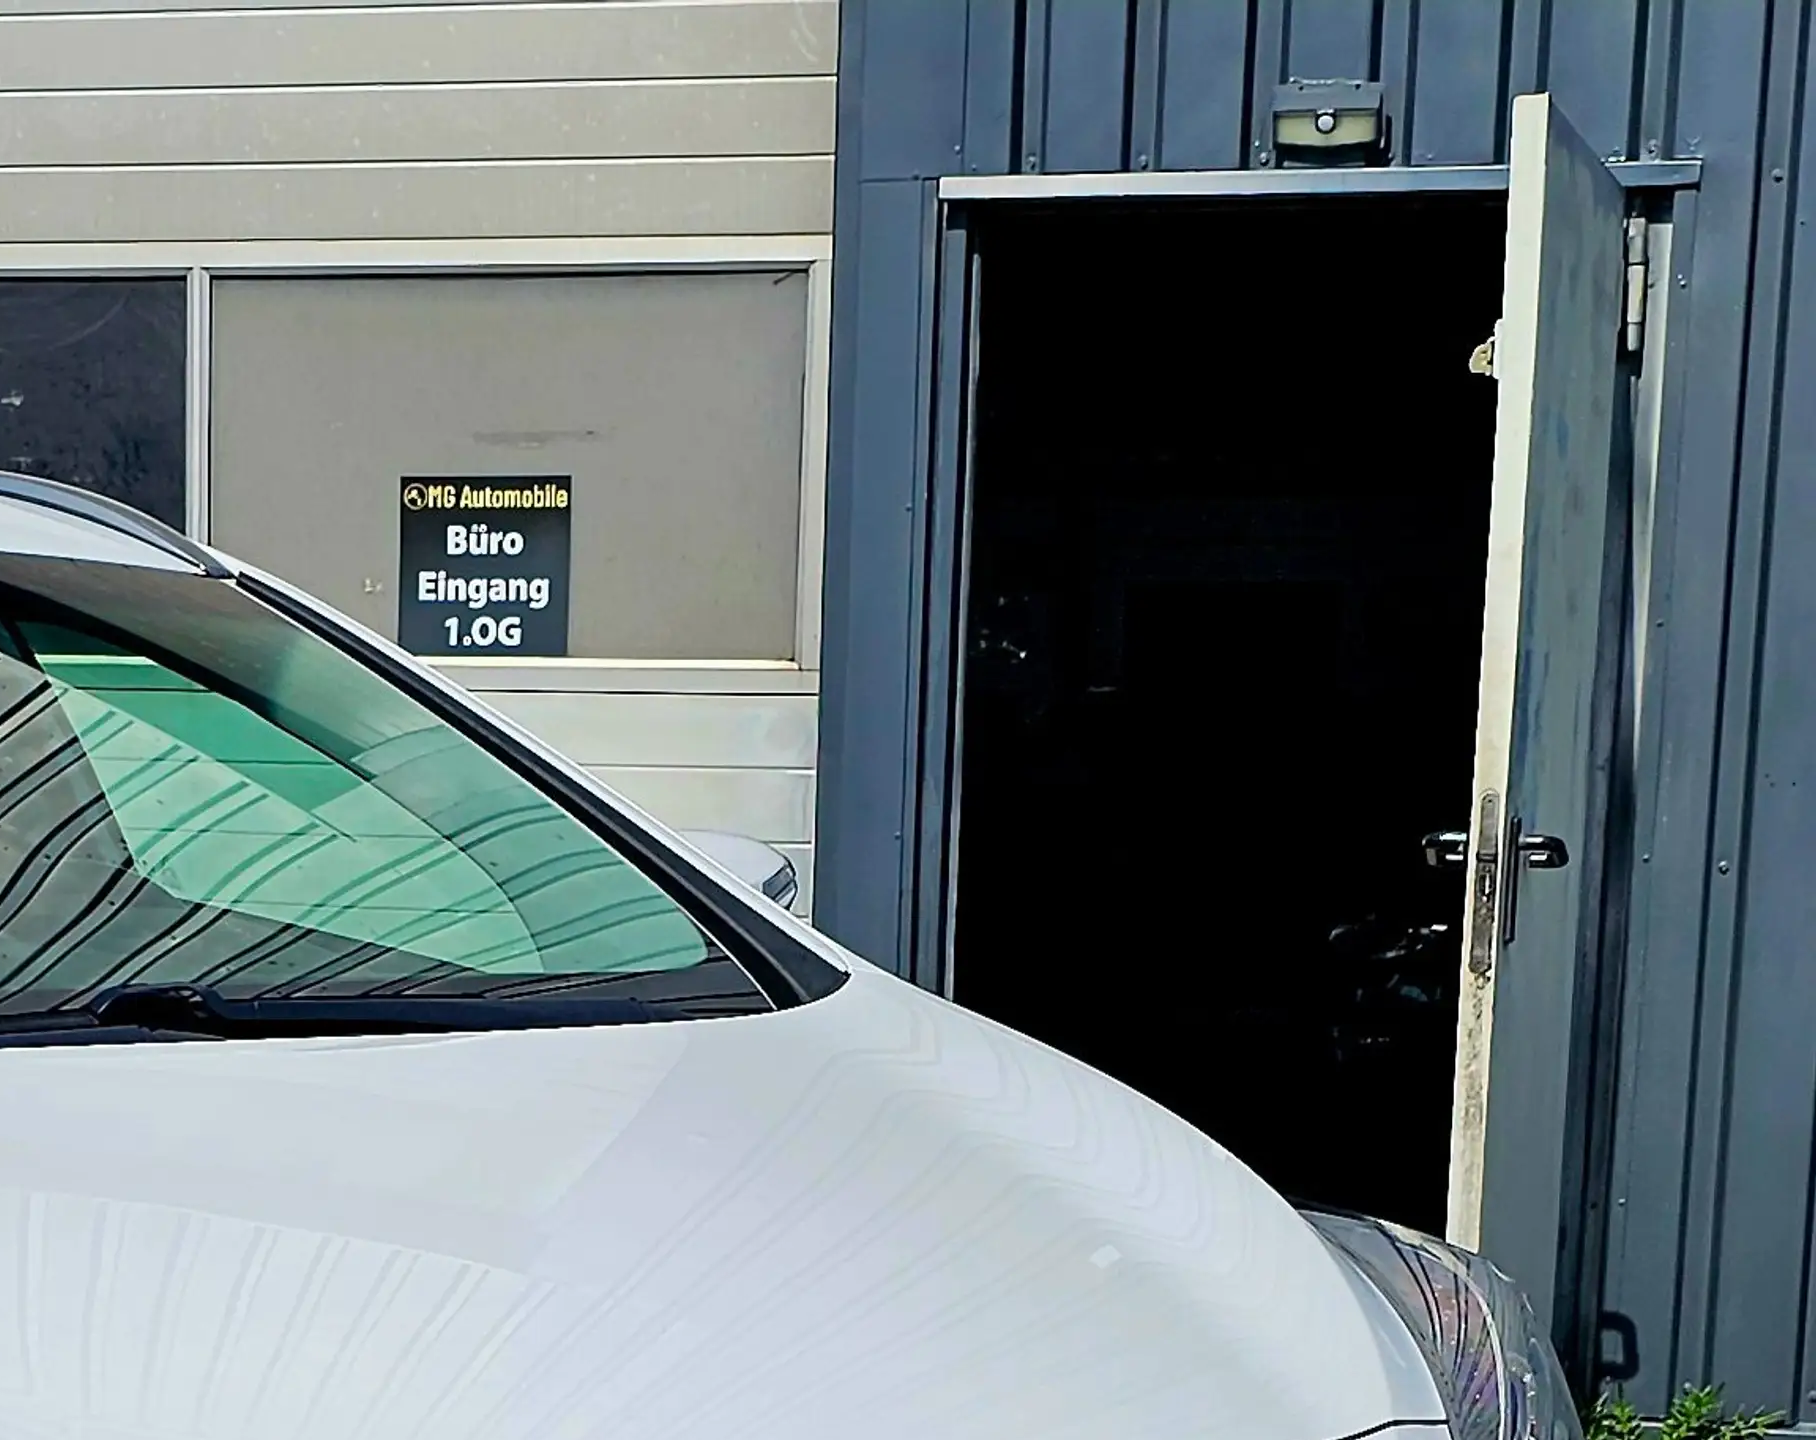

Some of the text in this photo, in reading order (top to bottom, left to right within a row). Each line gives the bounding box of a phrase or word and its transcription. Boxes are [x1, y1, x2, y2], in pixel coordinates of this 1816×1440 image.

[428, 485, 456, 509] MG
[460, 484, 568, 509] Automobile
[446, 523, 524, 555] Büro
[418, 570, 550, 609] Eingang
[444, 616, 522, 647] 1.OG
